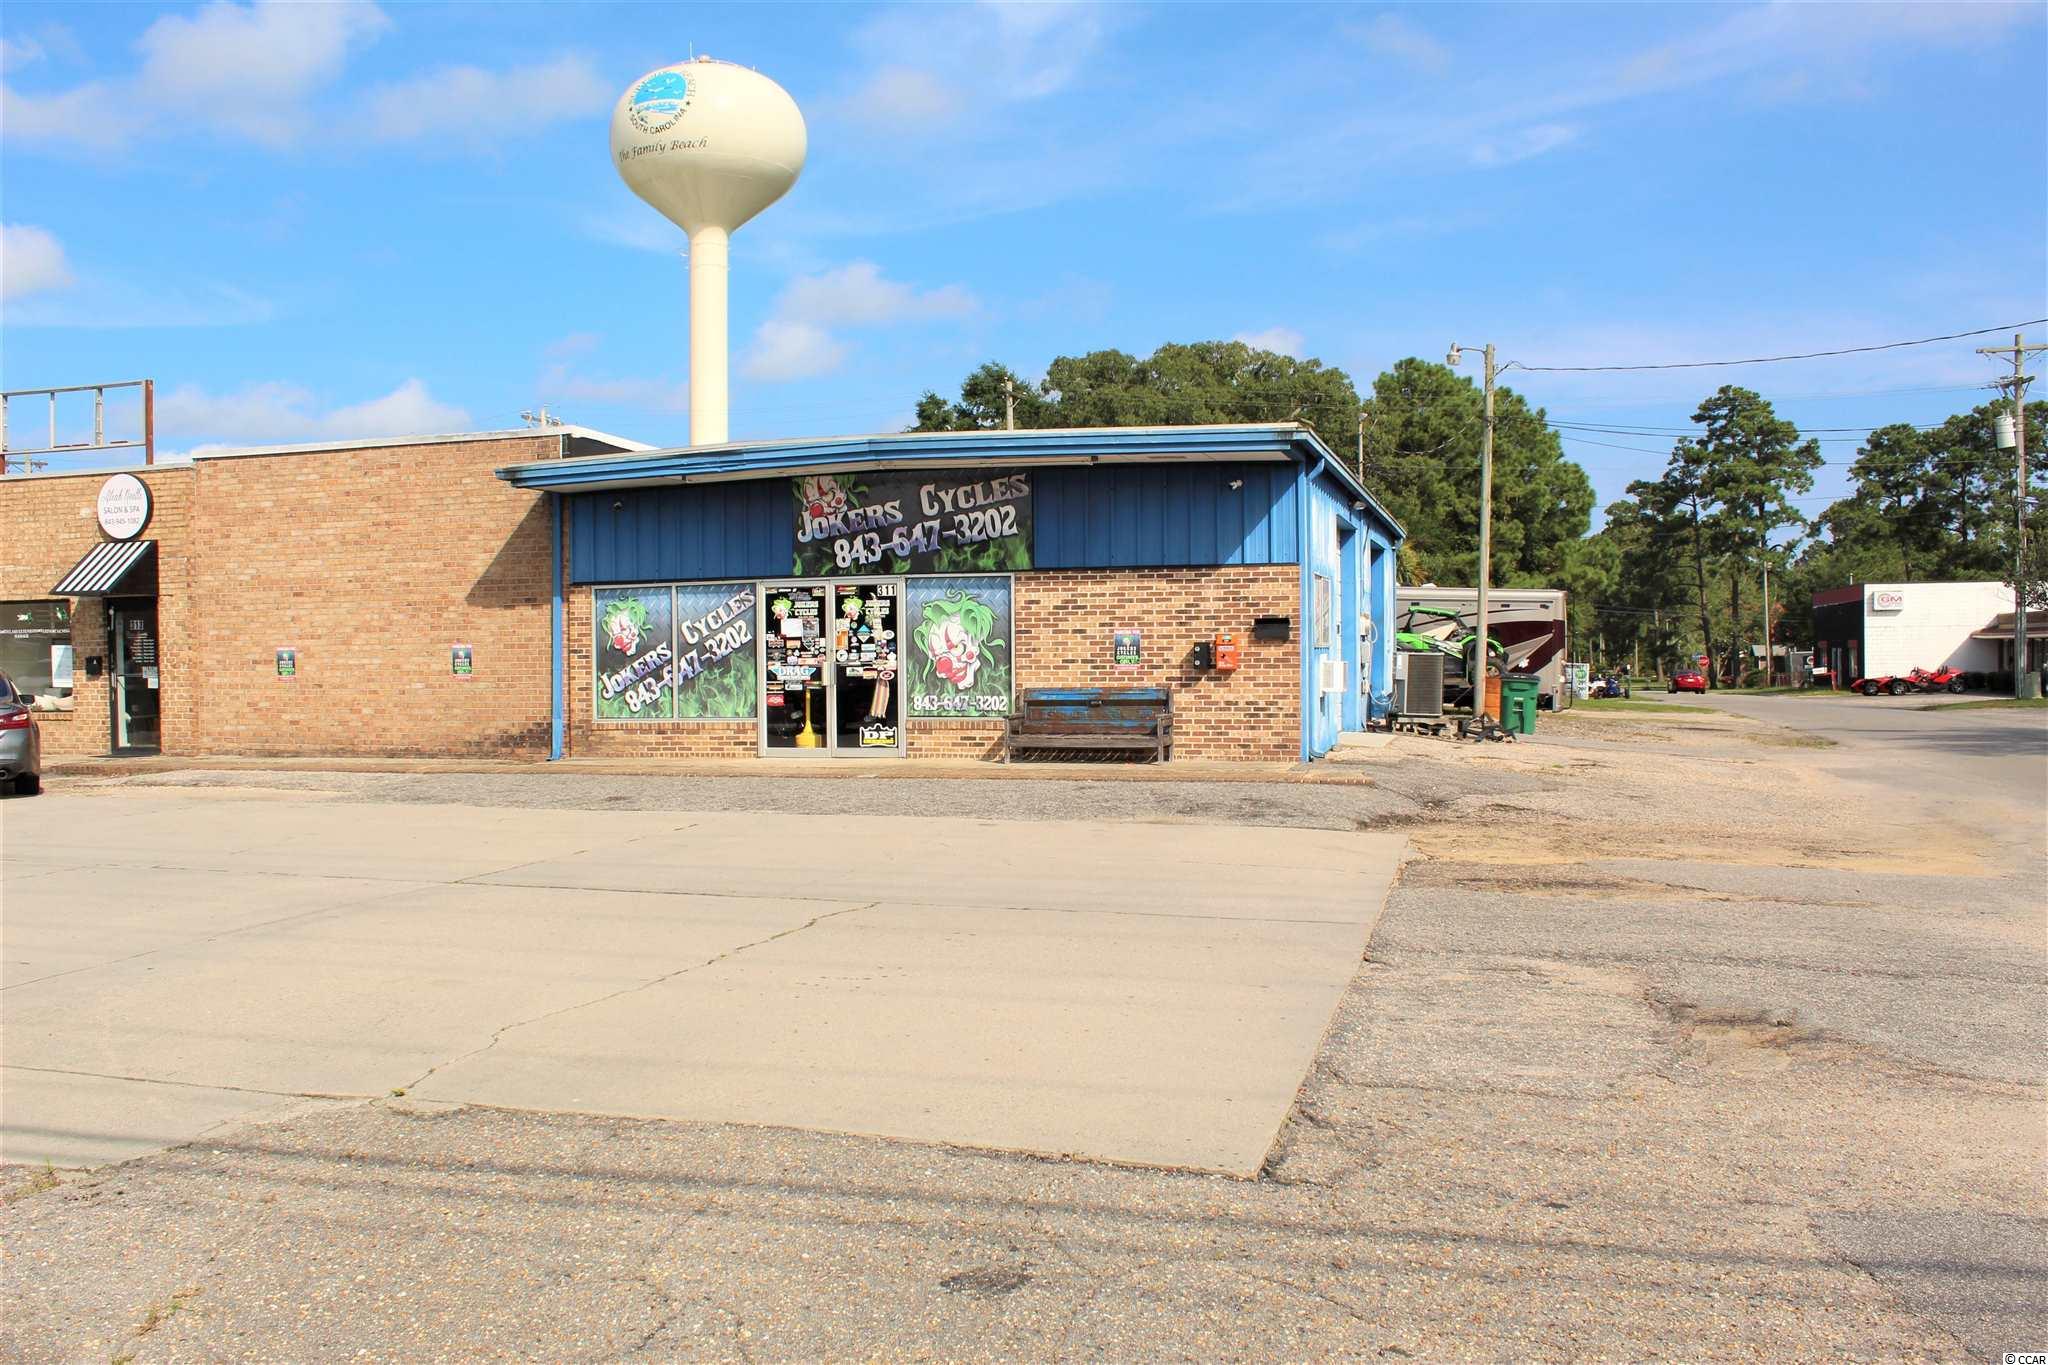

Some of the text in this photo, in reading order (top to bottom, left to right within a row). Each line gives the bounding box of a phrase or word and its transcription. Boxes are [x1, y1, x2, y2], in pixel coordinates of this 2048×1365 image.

[649, 108, 687, 135] CAROLINA
[671, 136, 708, 150] Beach
[798, 473, 1031, 543] JOKERS CYCLES
[834, 504, 1019, 568] 843-647-3202
[878, 585, 896, 596] 311
[600, 641, 672, 699] JOKERS
[681, 590, 755, 645] CYCLES
[624, 620, 752, 713] 843-647-3202
[913, 695, 1007, 712] 843-647-3202
